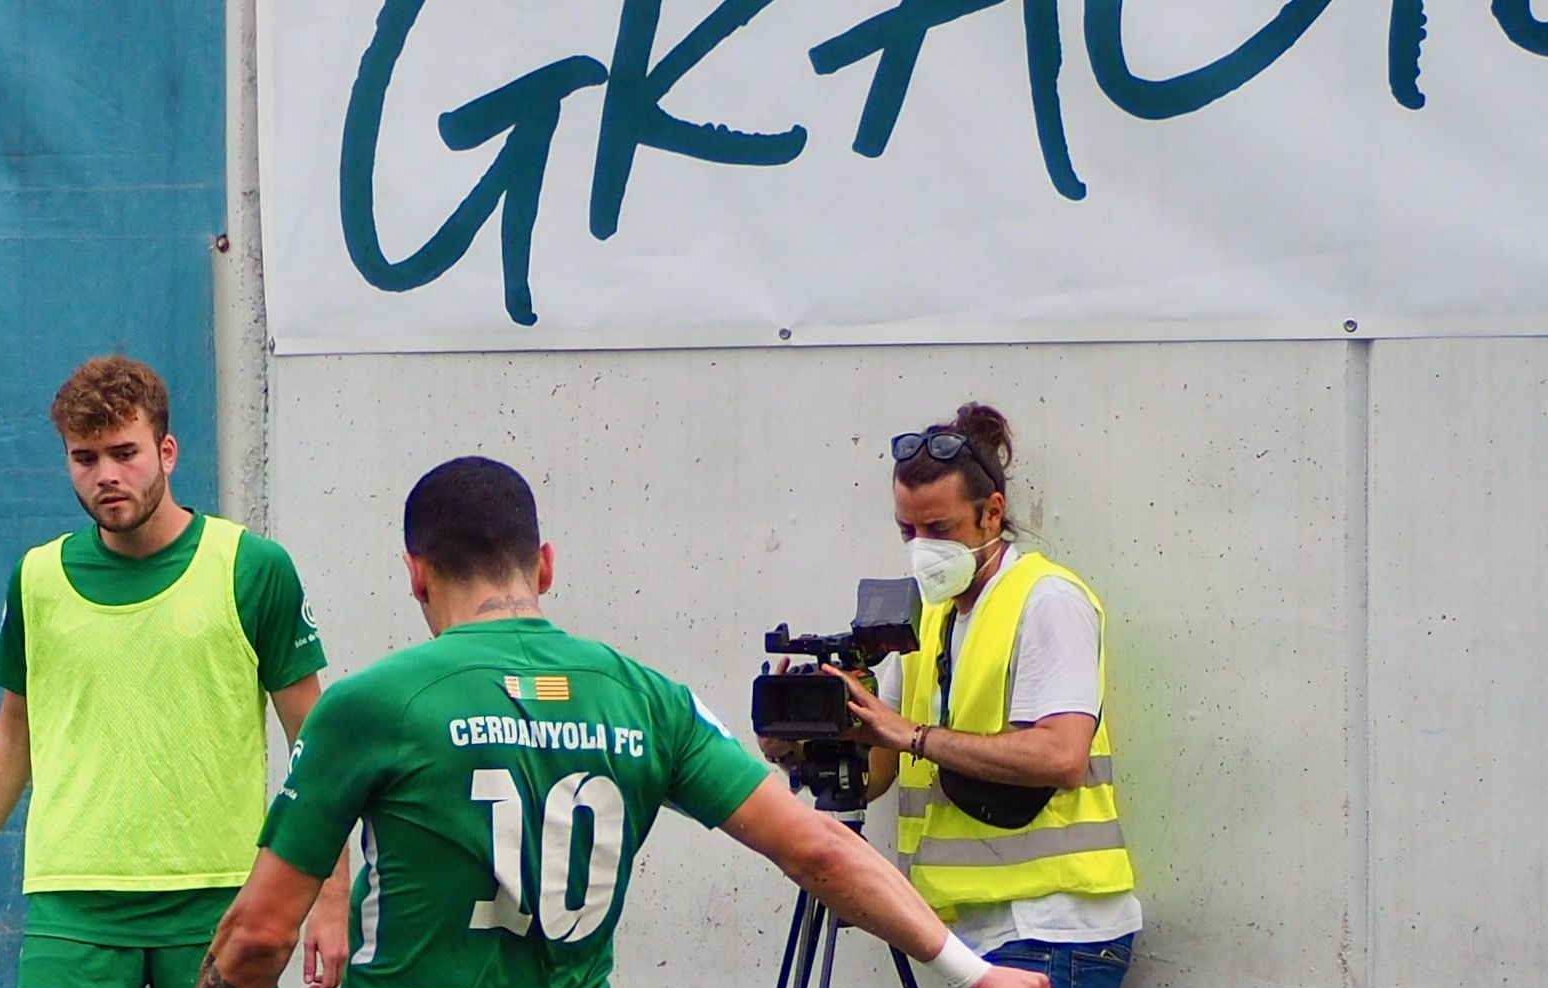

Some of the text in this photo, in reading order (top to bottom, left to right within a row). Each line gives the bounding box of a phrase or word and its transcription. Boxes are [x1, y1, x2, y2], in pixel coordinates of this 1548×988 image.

[449, 716, 644, 757] CERDANYOLA FC
[469, 769, 625, 943] 10
